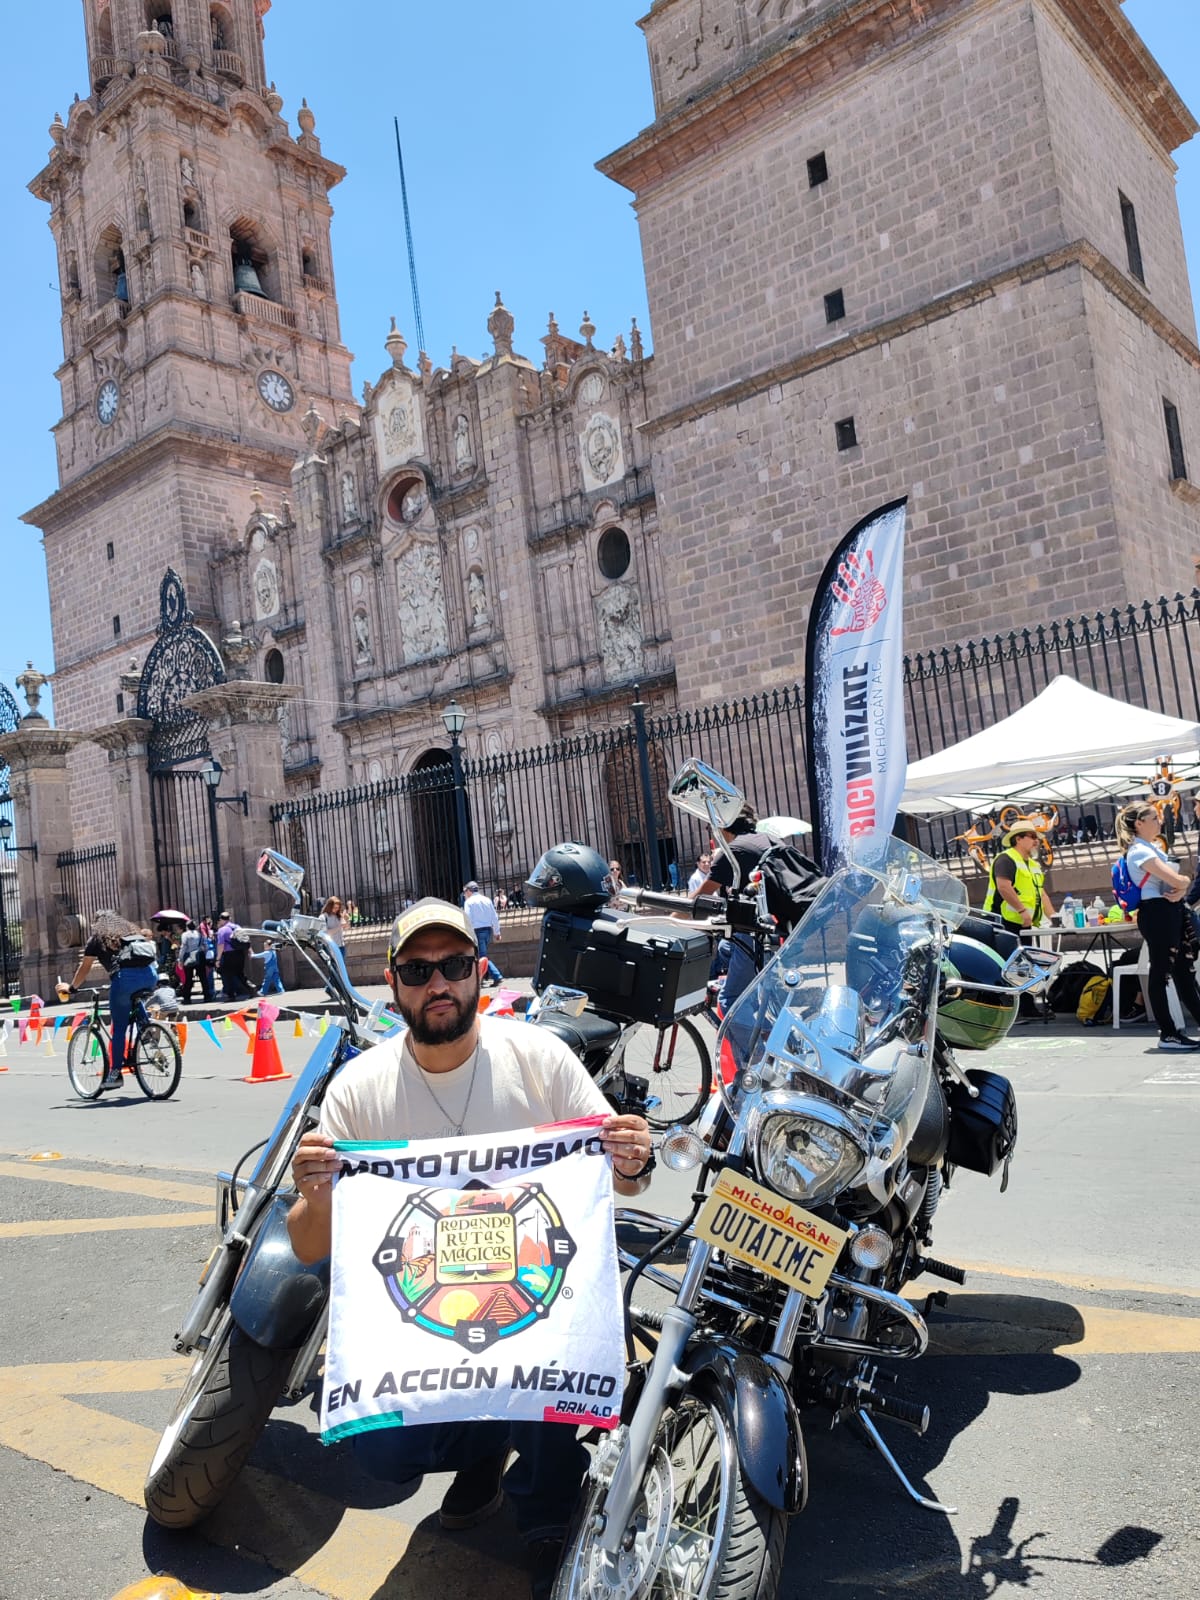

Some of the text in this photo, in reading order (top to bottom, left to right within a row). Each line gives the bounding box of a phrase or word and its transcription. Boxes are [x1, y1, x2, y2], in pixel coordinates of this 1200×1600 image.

[870, 689, 887, 774] MICHOACÁN
[338, 1136, 606, 1181] MOTOTURISMO
[731, 1186, 831, 1246] MICHOACÁN
[554, 1240, 569, 1254] E
[709, 1202, 825, 1285] OUTATIME
[468, 1327, 486, 1342] S
[328, 1358, 616, 1413] EN ACCIÓN MÉXICO
[556, 1399, 612, 1418] RRM 4.0
